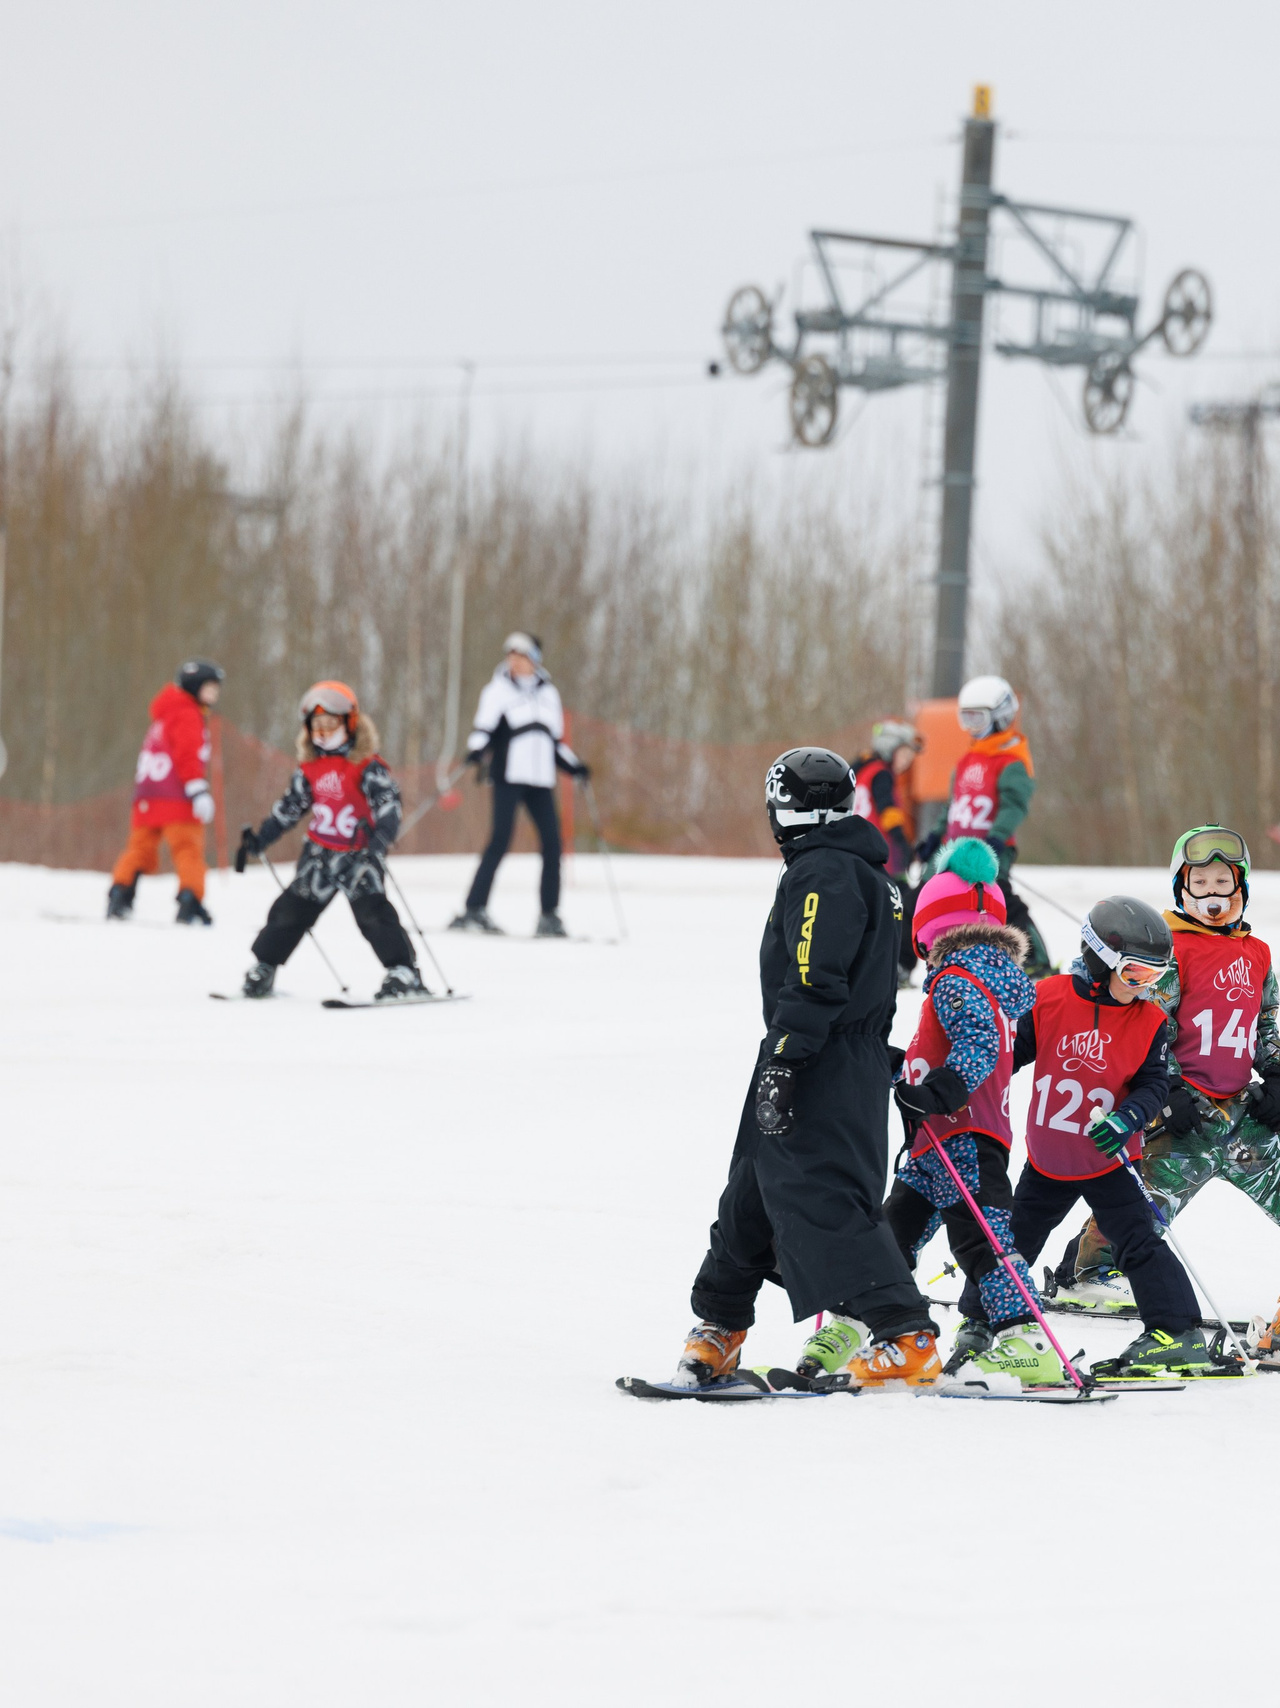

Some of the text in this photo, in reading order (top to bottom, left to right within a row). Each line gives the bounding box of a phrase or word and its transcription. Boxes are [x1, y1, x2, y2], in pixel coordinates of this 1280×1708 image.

[309, 803, 358, 838] 26
[1146, 1342, 1183, 1356] FISCHER
[998, 1357, 1040, 1370] DALBELLO
